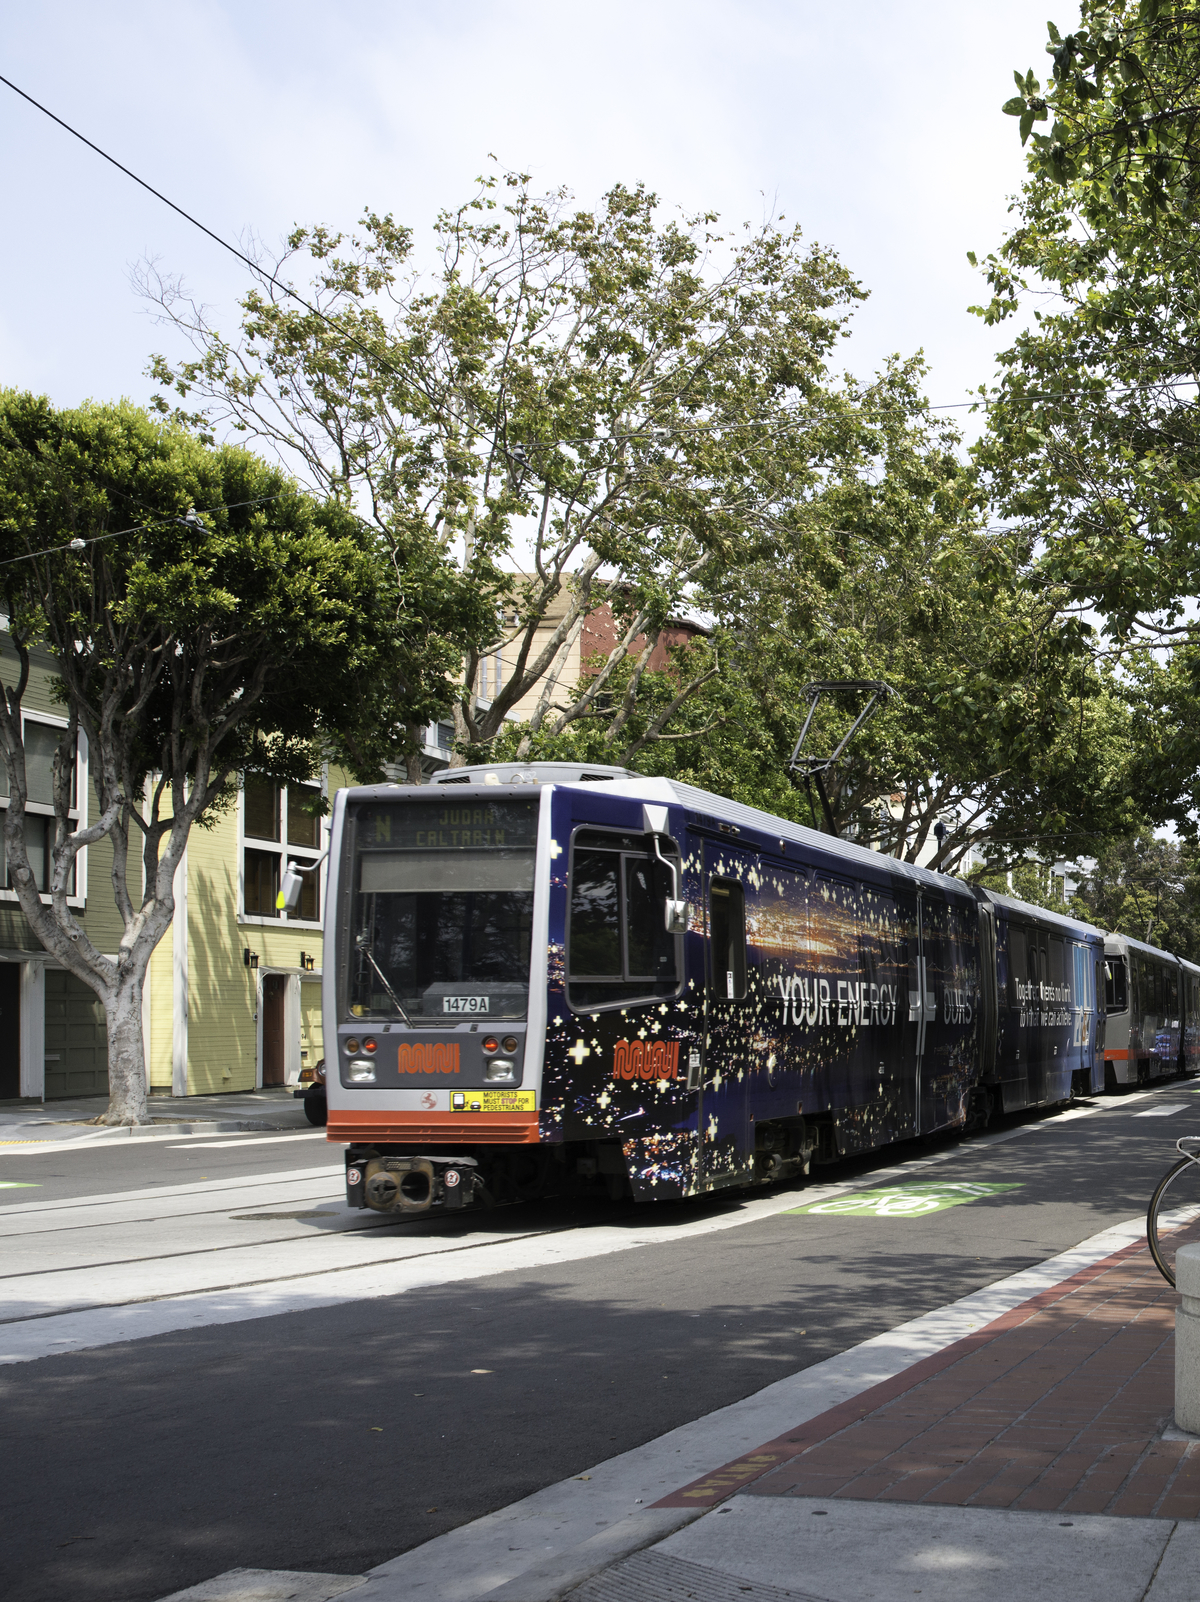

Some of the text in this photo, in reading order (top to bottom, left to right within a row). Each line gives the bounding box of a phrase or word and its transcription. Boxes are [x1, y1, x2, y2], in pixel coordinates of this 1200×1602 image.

[375, 815, 391, 842] N
[416, 829, 505, 847] CALTRAIN
[444, 997, 488, 1012] 1479A
[777, 975, 832, 1026] YOUR
[837, 980, 898, 1026] ENERGY
[943, 988, 973, 1025] OURS
[398, 1042, 460, 1074] MUNI
[612, 1039, 680, 1081] MUNI
